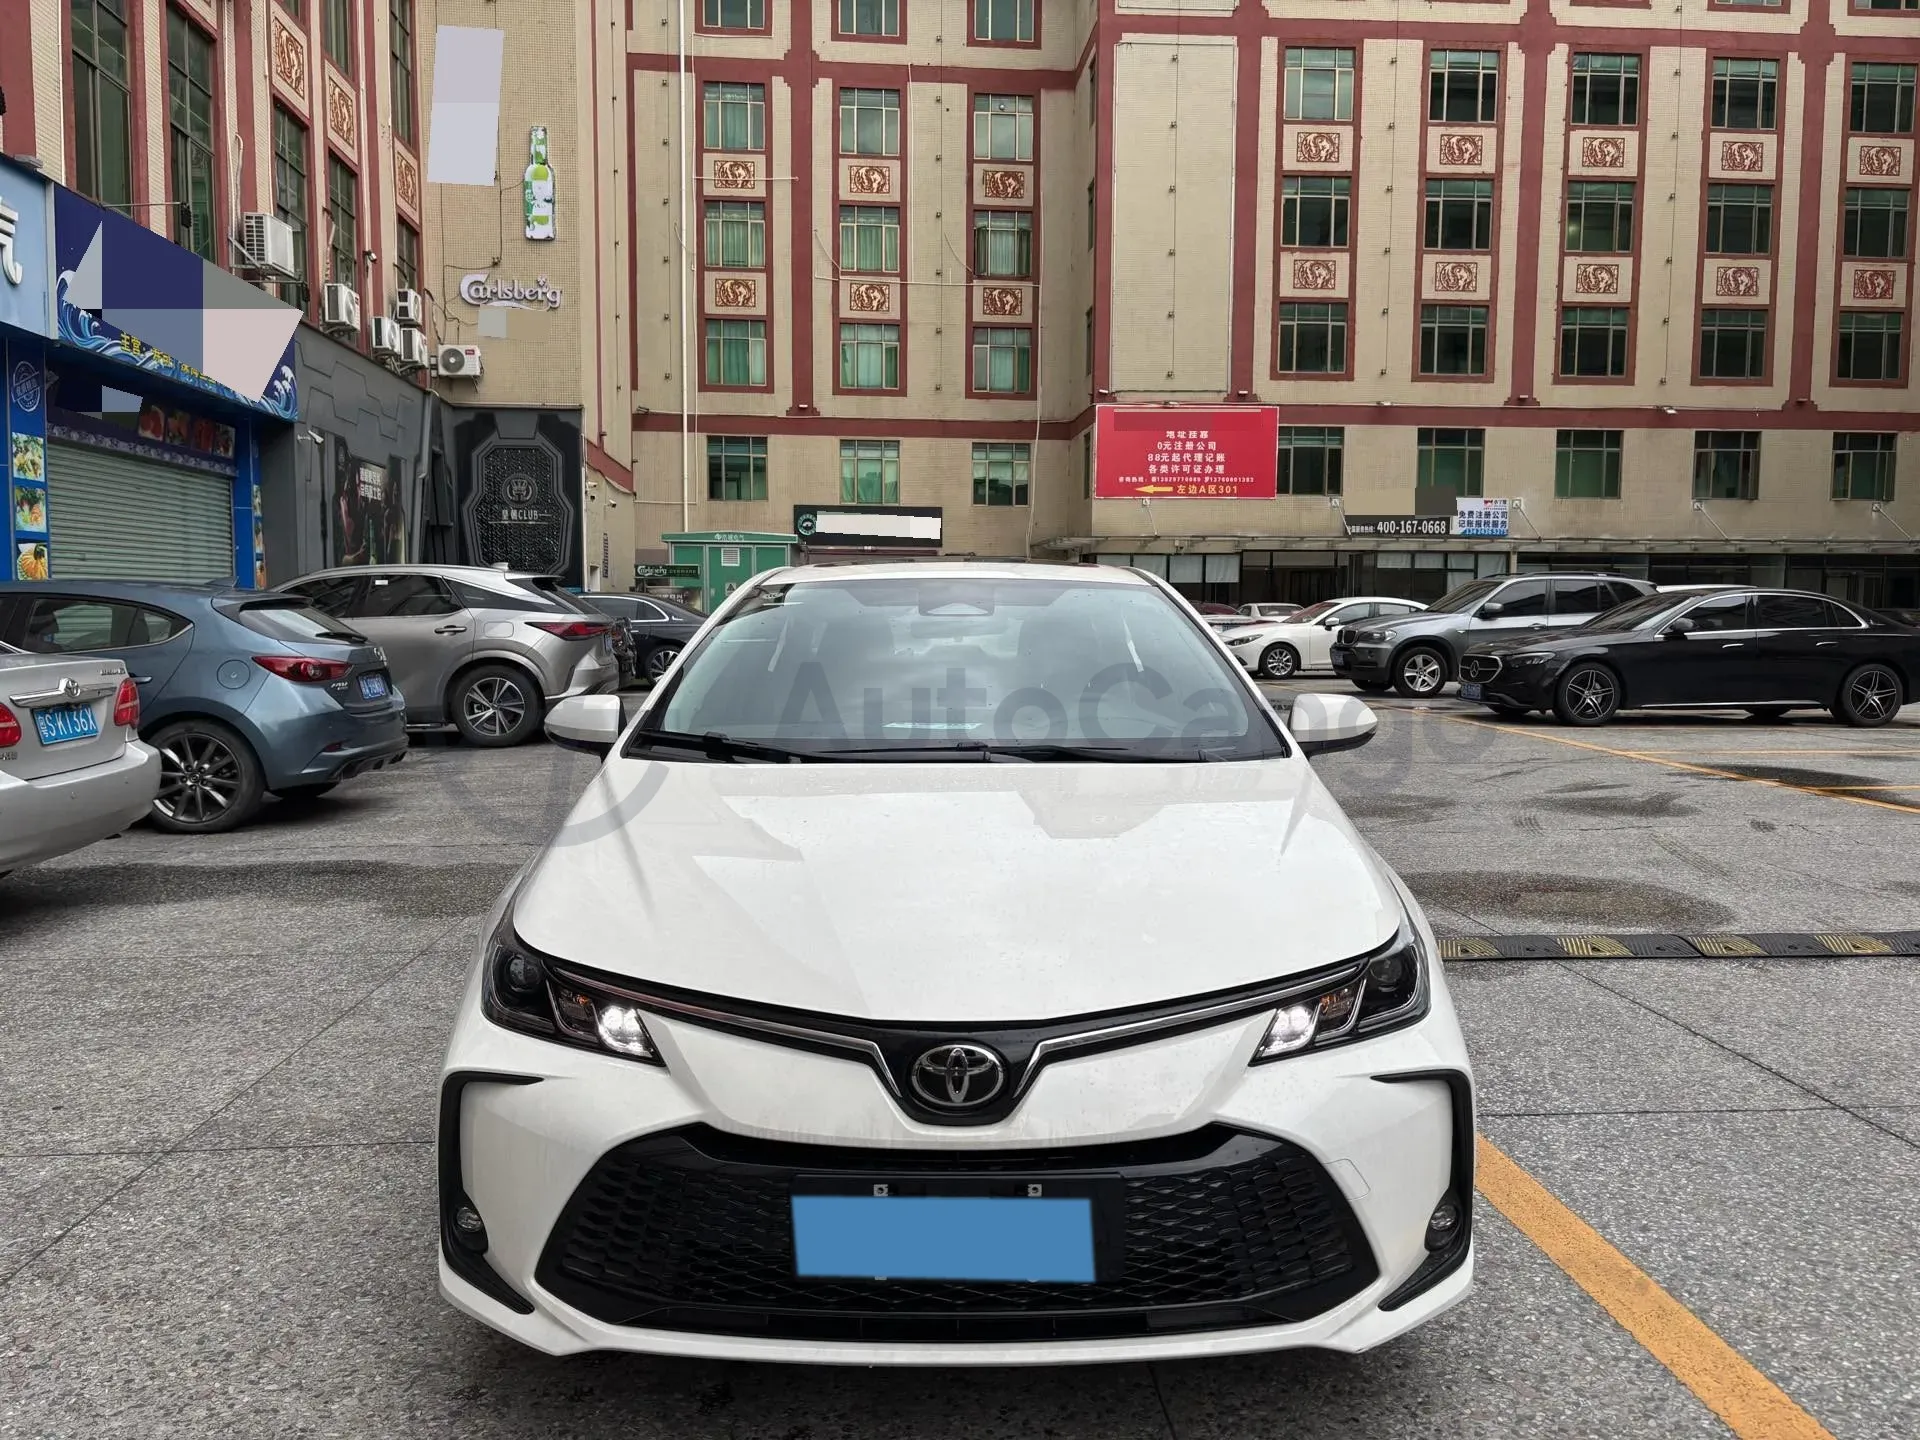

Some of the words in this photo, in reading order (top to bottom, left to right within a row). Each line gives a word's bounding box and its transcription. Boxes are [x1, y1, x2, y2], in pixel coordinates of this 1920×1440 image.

[459, 273, 563, 309] Carlsberg
[1157, 441, 1217, 450] 0元注册公司
[1147, 453, 1226, 462] 88元起代理记账
[1148, 464, 1225, 473] 各类许可证办理
[1177, 484, 1238, 494] 左边A区301
[1459, 510, 1508, 519] 免费注册公司
[1377, 520, 1446, 534] 400-167-0668
[1459, 519, 1507, 528] 记账报税服务
